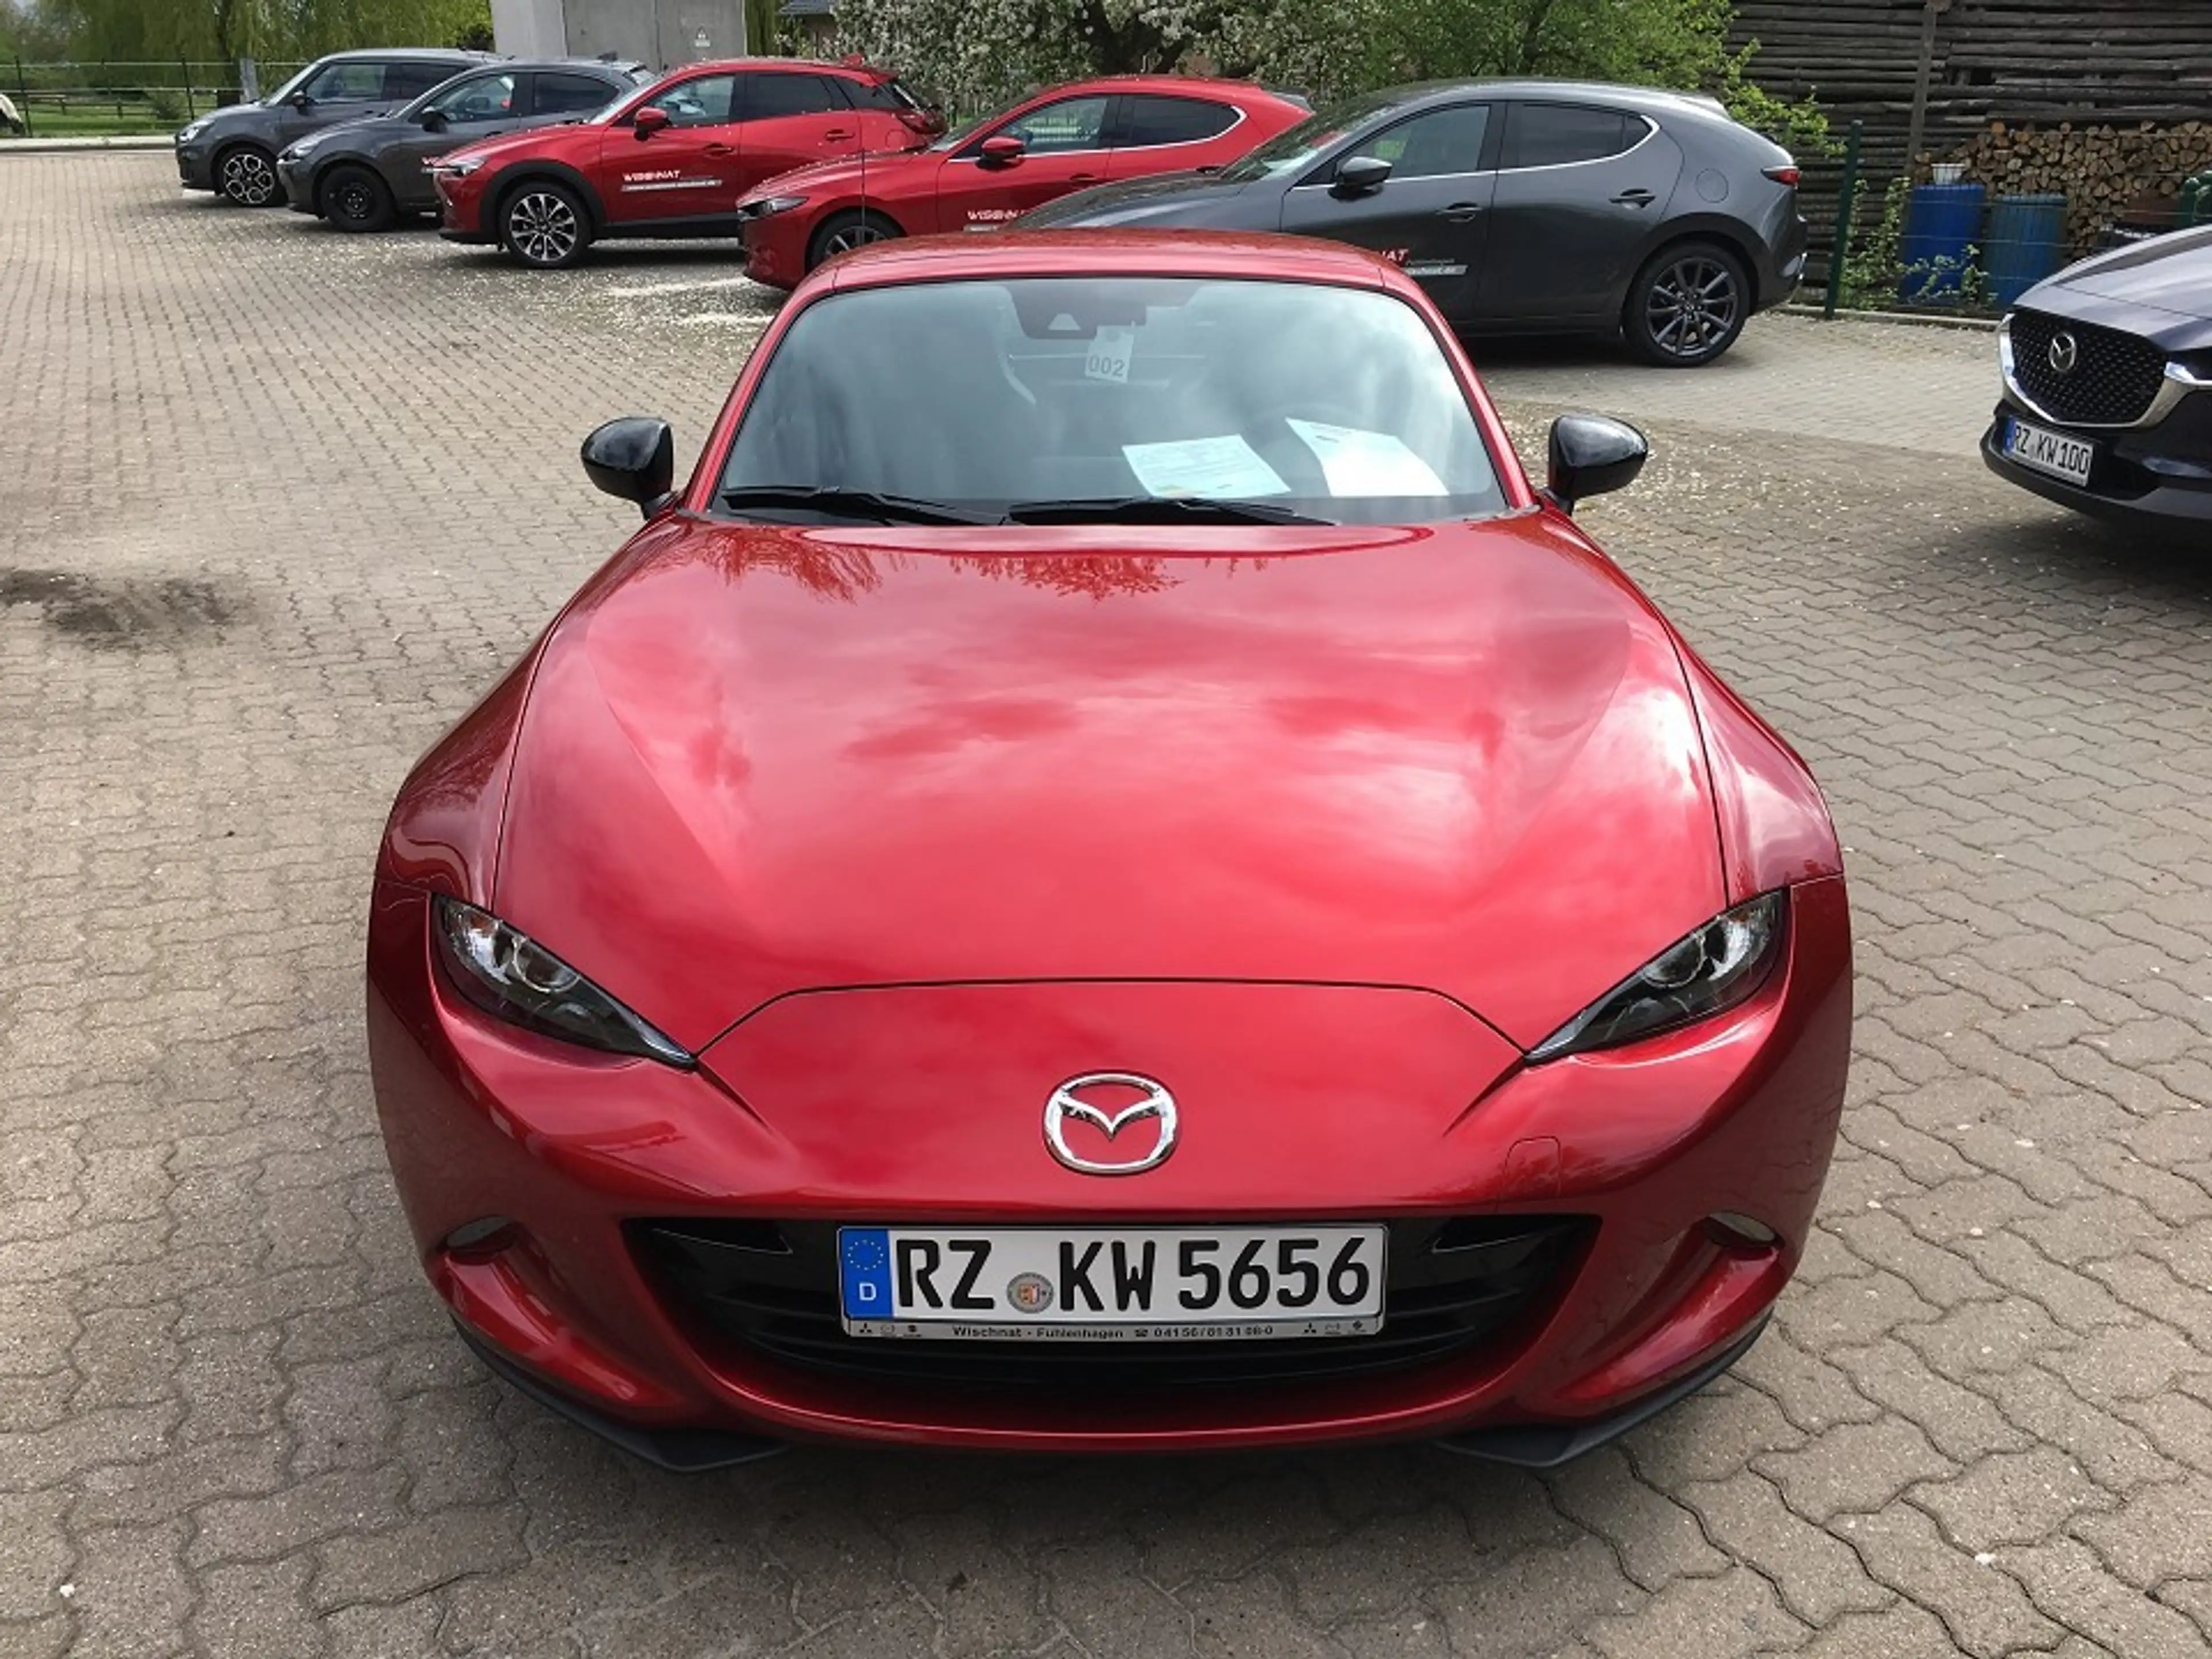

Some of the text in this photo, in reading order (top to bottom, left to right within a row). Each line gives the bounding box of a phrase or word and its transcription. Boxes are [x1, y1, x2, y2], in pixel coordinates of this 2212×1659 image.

[1088, 354, 1126, 377] 002
[2037, 433, 2059, 464] KW
[2058, 442, 2089, 475] 100
[896, 1239, 995, 1309] RZ
[1059, 1240, 1156, 1312] KW
[1178, 1237, 1369, 1310] 5656
[859, 1282, 877, 1301] D
